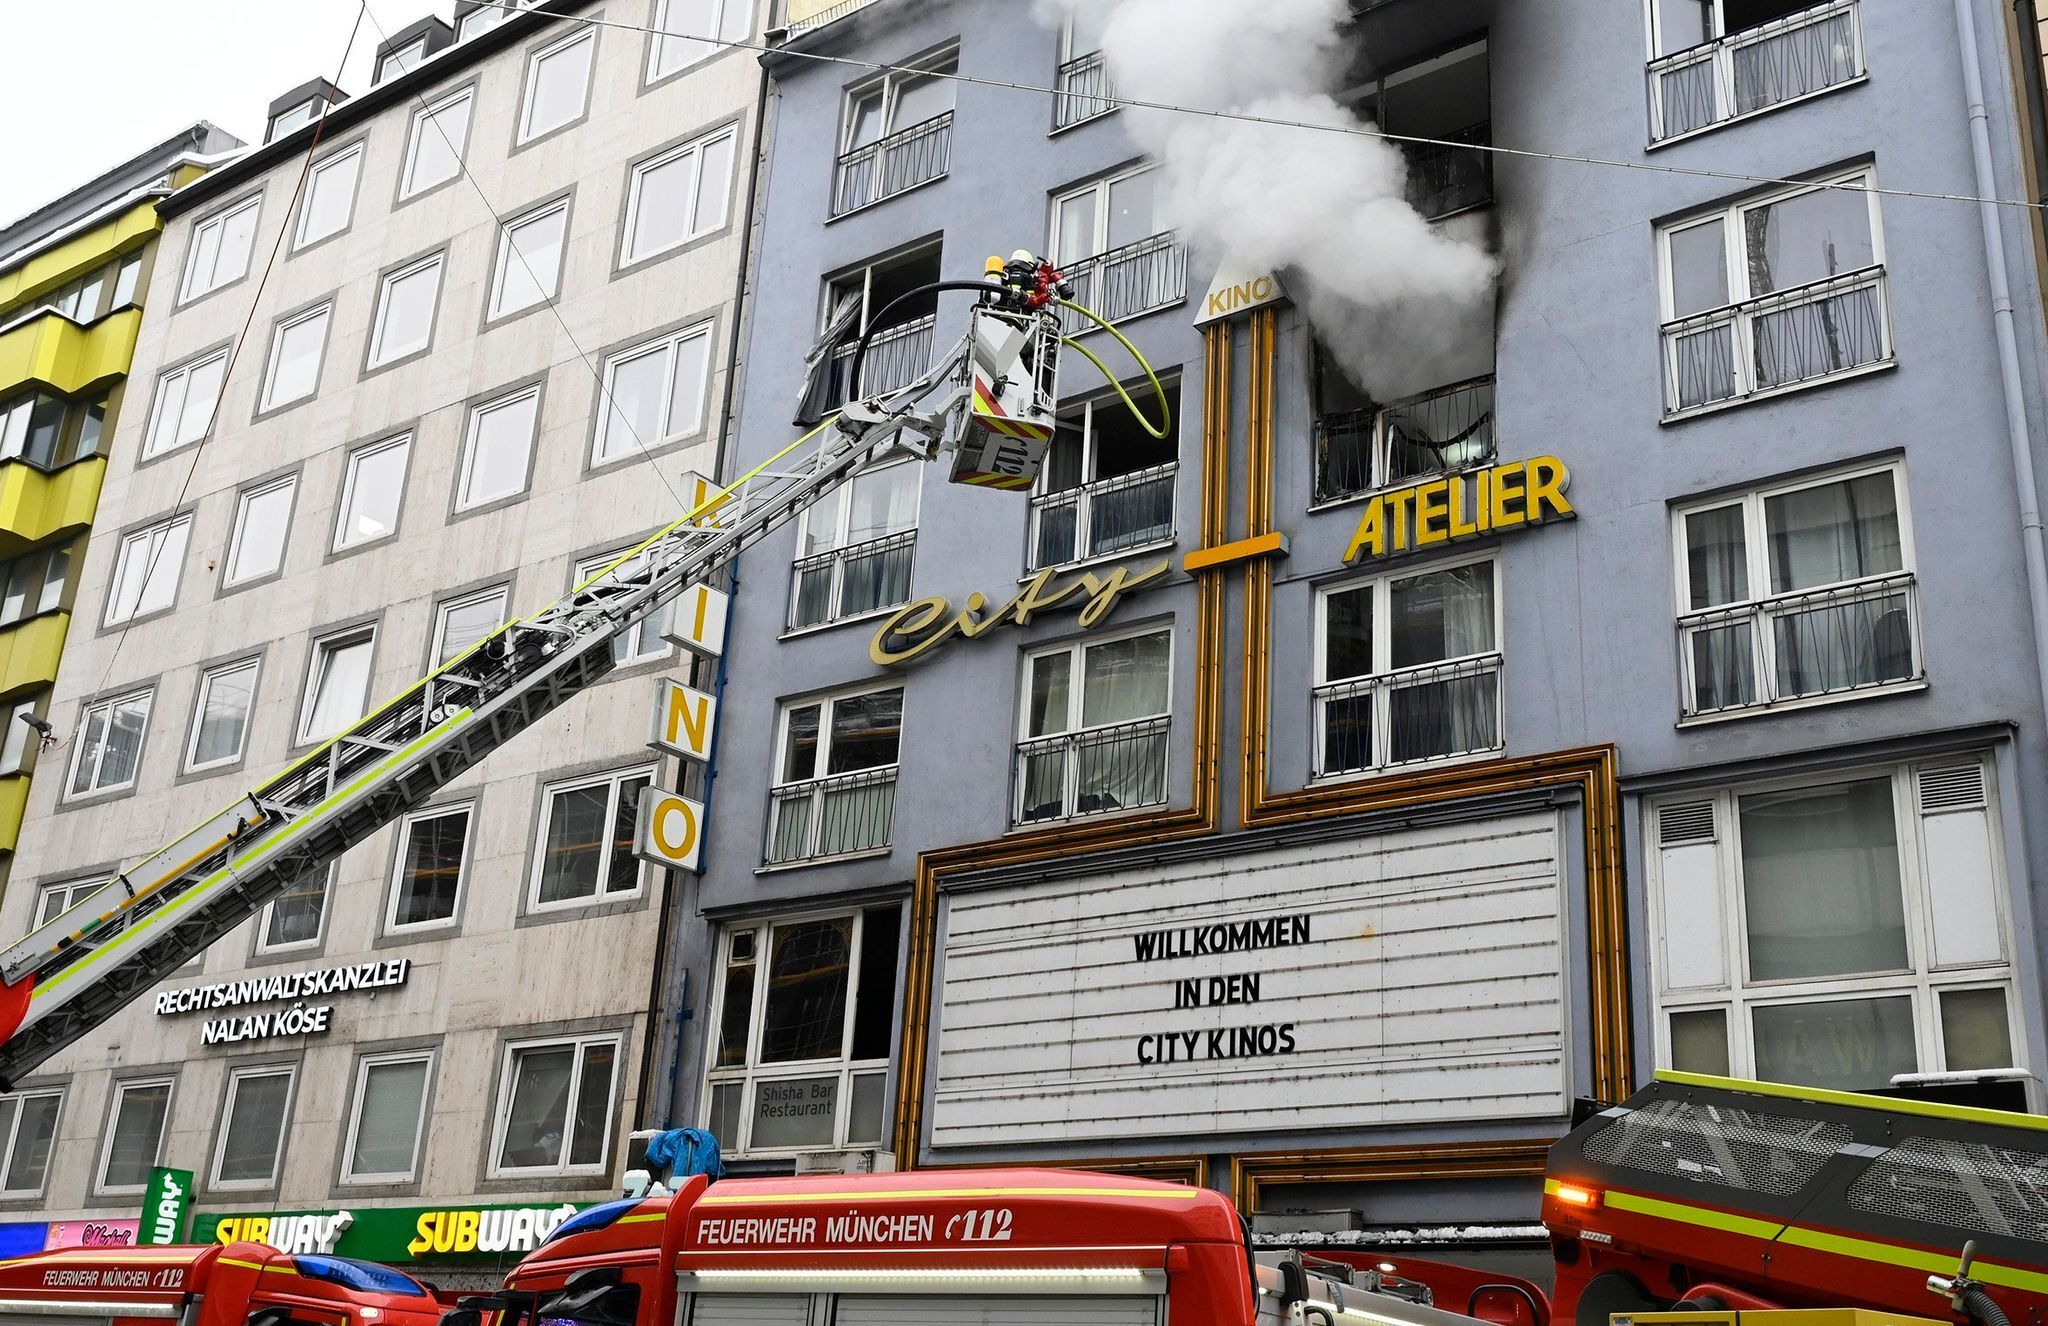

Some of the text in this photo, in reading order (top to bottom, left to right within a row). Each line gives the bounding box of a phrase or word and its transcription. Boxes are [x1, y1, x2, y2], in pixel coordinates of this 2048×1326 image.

[1208, 276, 1272, 316] KINO
[1343, 455, 1575, 563] ATELIER
[869, 559, 1172, 667] City
[1134, 914, 1310, 962] WILLKOMMEN
[153, 958, 409, 1015] RECHTSANWALTSKANZLEI
[1175, 972, 1260, 1009] IN DEN
[200, 1002, 331, 1045] NALAN KÖSE
[1137, 1023, 1296, 1064] CITY KINOS
[760, 1101, 833, 1118] Restaurant
[762, 1084, 834, 1101] Shisha Bar
[214, 1210, 354, 1255] SUBWAY
[407, 1203, 578, 1257] SUBWAY
[697, 1208, 1013, 1244] FEUERWEHR MÜNCHEN 112
[42, 1267, 184, 1288] FEUERWEHR MÜNCHEN 112
